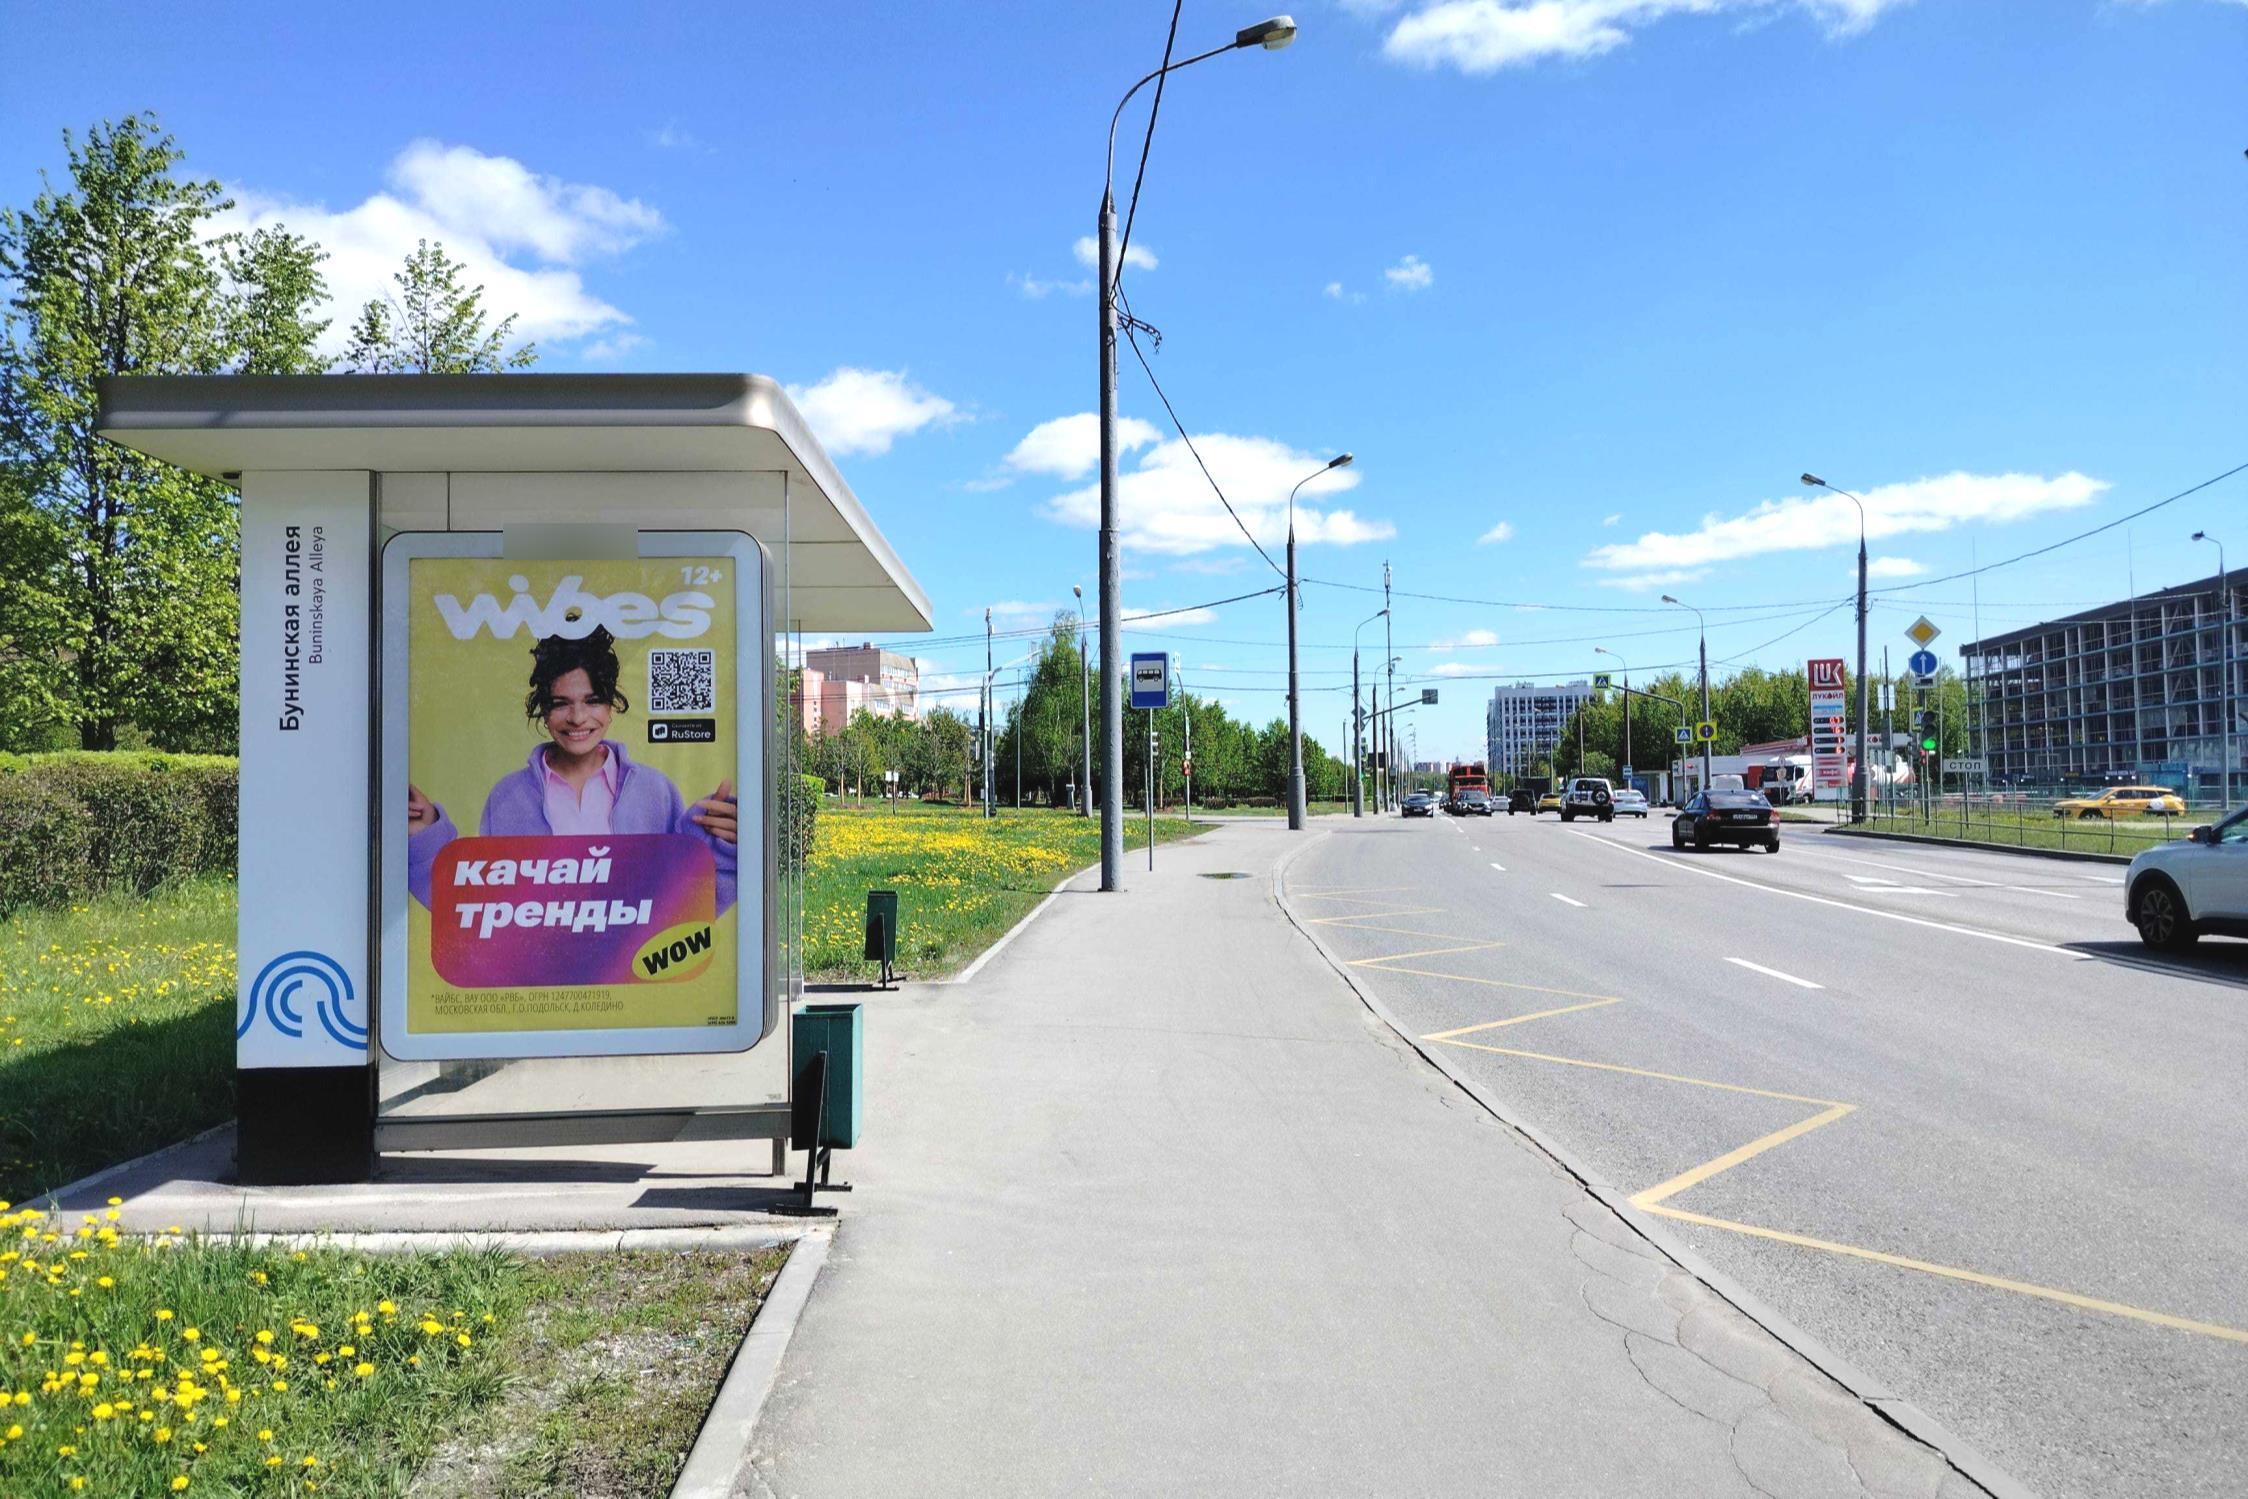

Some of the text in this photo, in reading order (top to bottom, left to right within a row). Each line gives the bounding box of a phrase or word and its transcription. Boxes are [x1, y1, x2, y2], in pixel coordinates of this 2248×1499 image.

[680, 566, 723, 585] 12+
[308, 526, 326, 665] Buninskaya Alleya
[433, 574, 716, 641] wibes
[279, 526, 304, 731] Бунинская аллея
[671, 729, 711, 739] RuStore
[1950, 762, 1981, 770] СТОП
[453, 845, 612, 886] качай
[455, 899, 653, 939] тренды
[435, 1004, 488, 1015] МОСКОВСКАЯ
[465, 993, 479, 1003] ВАУ
[481, 992, 498, 1003] ООО
[528, 991, 549, 1001] ОГРН
